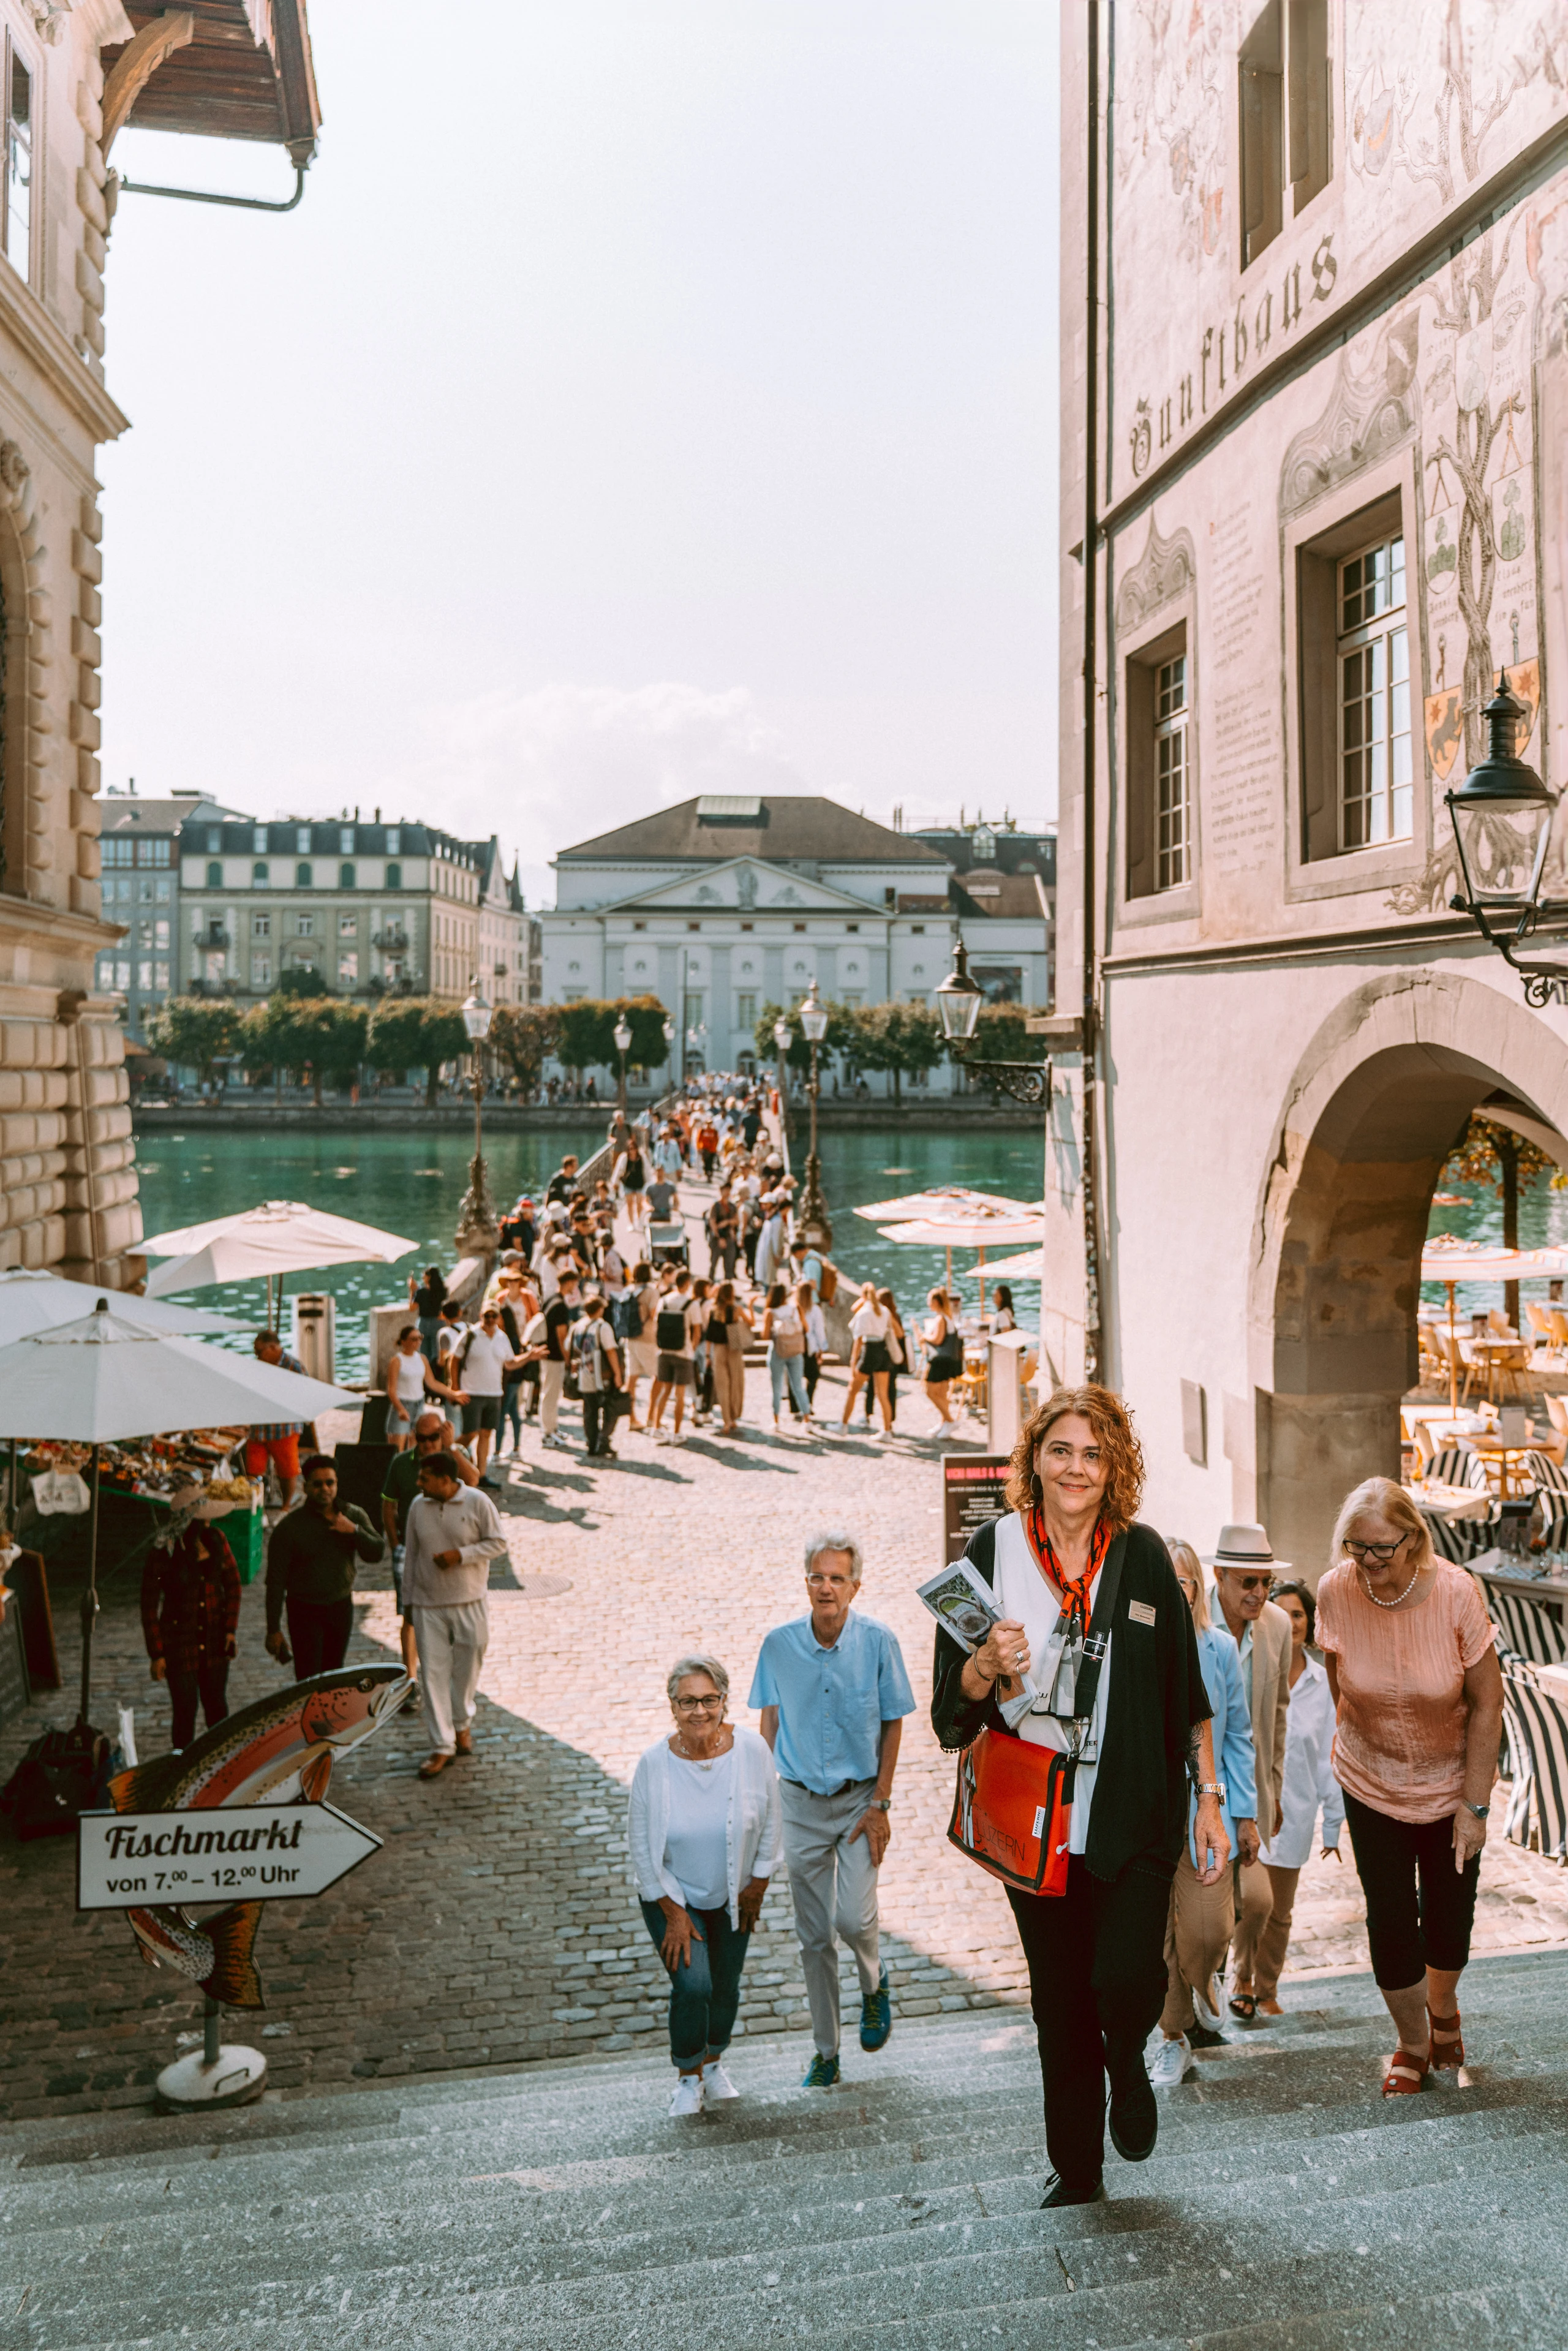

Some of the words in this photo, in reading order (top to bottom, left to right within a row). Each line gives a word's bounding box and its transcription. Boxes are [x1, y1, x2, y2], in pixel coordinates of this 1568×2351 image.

[105, 1819, 303, 1860] Fischmarkt
[976, 1817, 1025, 1862] LUZERN
[107, 1873, 147, 1893] von
[261, 1865, 300, 1884] Uhr
